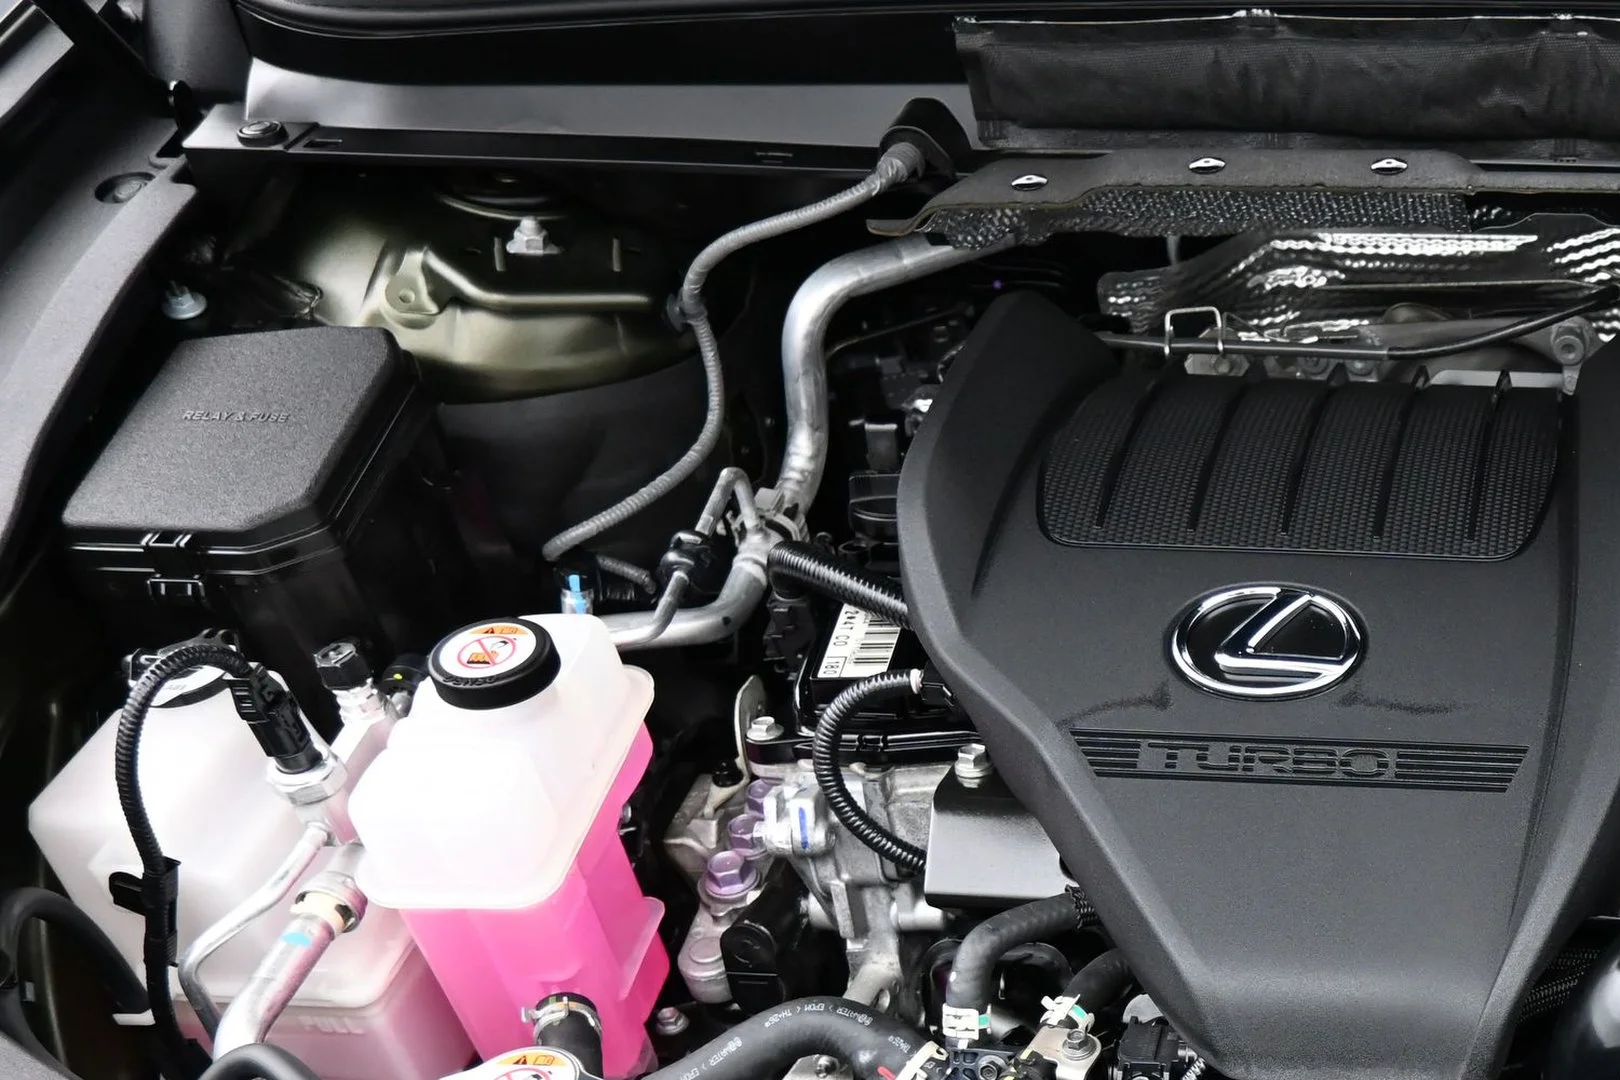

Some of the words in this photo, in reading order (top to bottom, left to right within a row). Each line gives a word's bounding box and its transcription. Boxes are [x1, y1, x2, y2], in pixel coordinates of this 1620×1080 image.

[182, 410, 234, 421] RELAY
[249, 411, 290, 423] FUSE
[1148, 742, 1389, 777] TURBO
